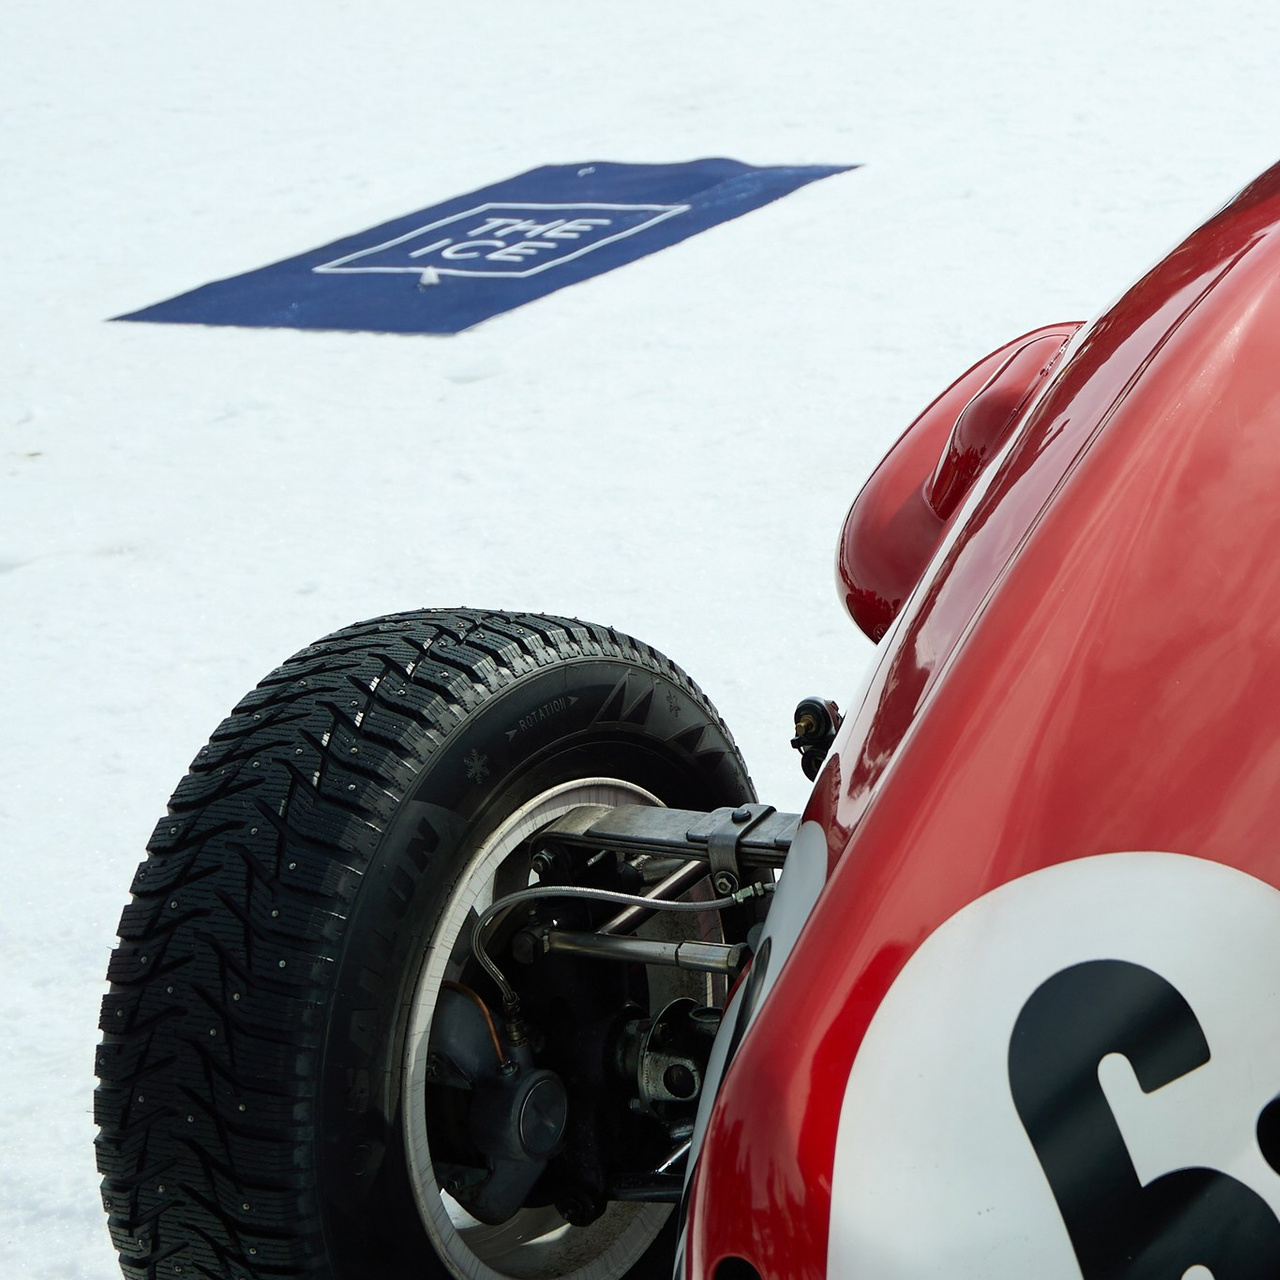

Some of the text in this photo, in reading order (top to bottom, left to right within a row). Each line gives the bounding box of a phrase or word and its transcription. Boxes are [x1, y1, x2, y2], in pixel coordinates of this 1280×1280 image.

[467, 218, 612, 238] THE
[408, 238, 557, 262] ICE
[518, 697, 567, 732] ROTATION
[347, 815, 441, 1114] SAILUN
